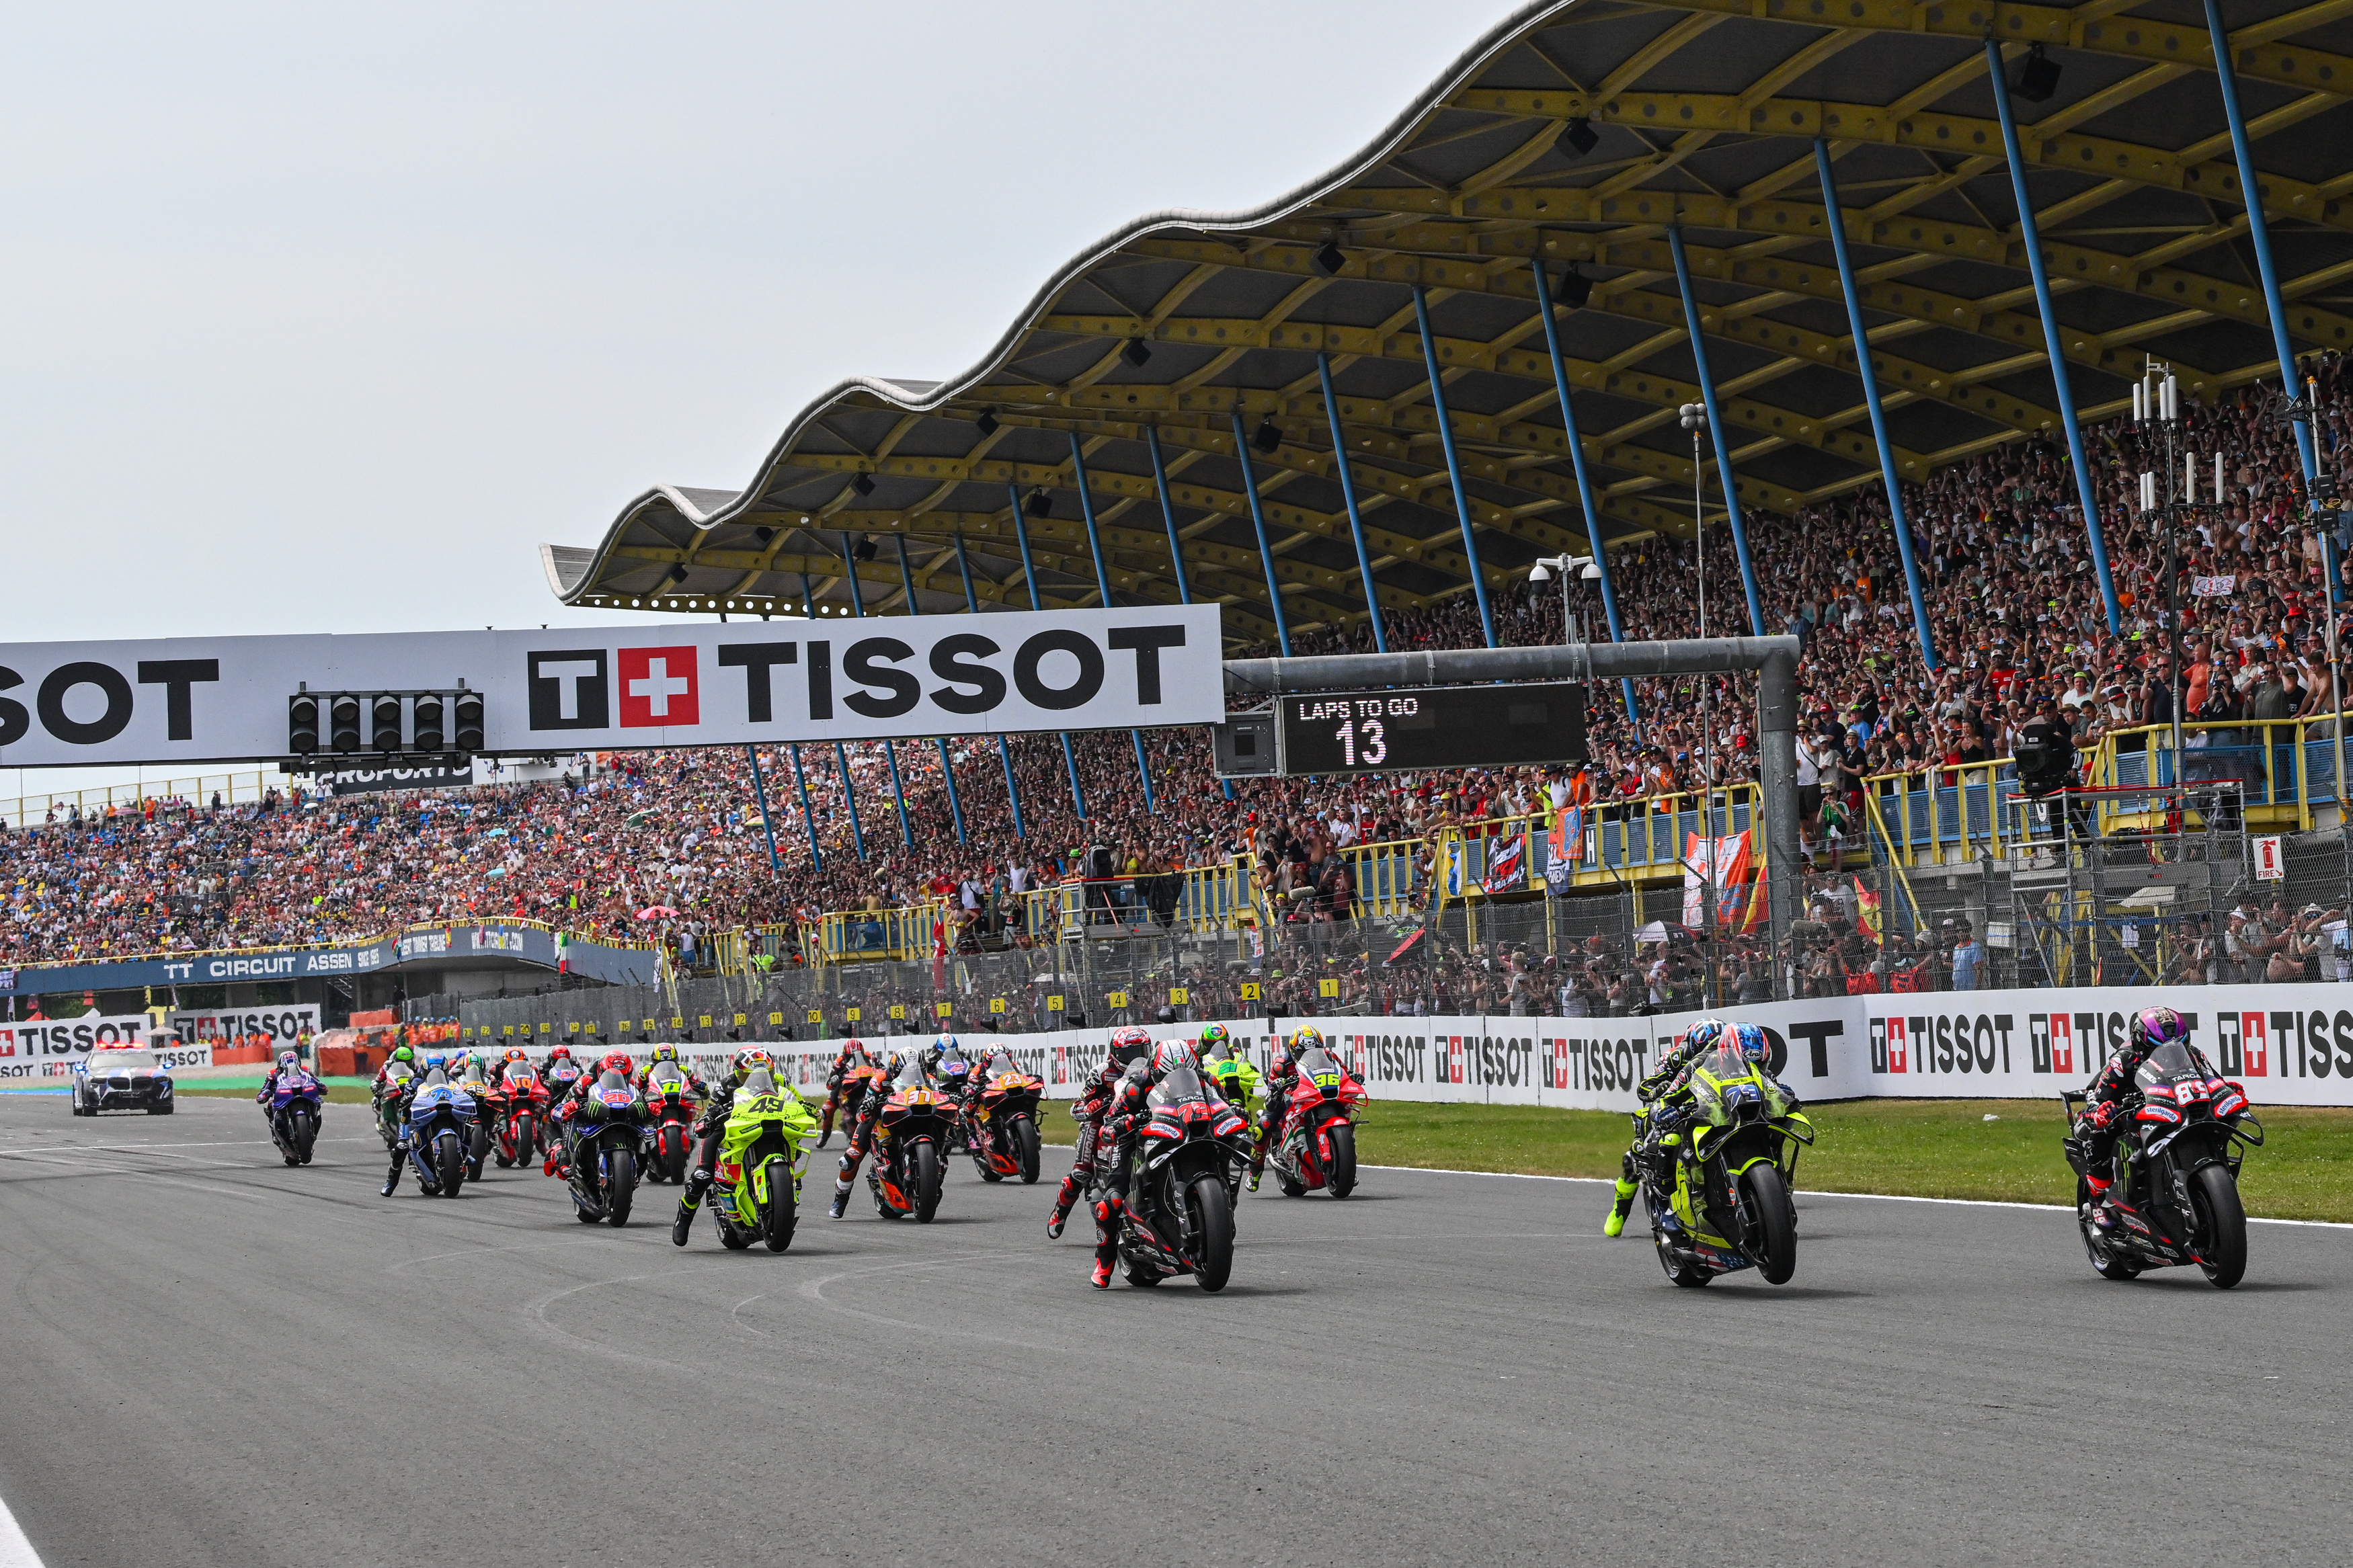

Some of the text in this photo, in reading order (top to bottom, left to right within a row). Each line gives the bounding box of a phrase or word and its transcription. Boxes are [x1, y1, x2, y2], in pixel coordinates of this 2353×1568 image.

[718, 625, 1186, 722] TISSOT
[1300, 698, 1419, 720] LAPS TO GO
[1336, 719, 1386, 765] 13
[1586, 829, 1595, 864] H
[2258, 869, 2275, 878] FIRE
[163, 963, 194, 979] TT
[209, 957, 296, 977] CIRCUIT
[307, 952, 352, 971] ASSEN
[1246, 984, 1254, 999] 2
[1326, 981, 1331, 995] 1
[1052, 997, 1059, 1009] 5
[1115, 993, 1121, 1006] 4
[1175, 990, 1183, 1003] 3
[942, 1005, 947, 1015] 7
[994, 1000, 1000, 1011] 6
[736, 1014, 745, 1024] 12
[772, 1014, 780, 1022] 11
[809, 1012, 818, 1022] 10
[850, 1011, 855, 1020] 9
[894, 1007, 900, 1018] 8
[220, 1011, 313, 1044] TISSOT
[621, 1022, 629, 1030] 16
[673, 1019, 682, 1027] 14
[701, 1018, 710, 1026] 13
[521, 1025, 529, 1033] 20
[18, 1022, 141, 1055] TISSOT
[1908, 1014, 2014, 1074] TISSOT
[1365, 1035, 1426, 1083] TISSOT
[1464, 1036, 1533, 1087] TISSOT
[1743, 1050, 1763, 1060] Arai
[1066, 1044, 1106, 1083] TISSOT
[1218, 1062, 1238, 1075] 21
[1568, 1038, 1647, 1092] TISSOT
[514, 1077, 532, 1089] 10
[1002, 1074, 1022, 1086] 23
[1314, 1074, 1340, 1089] 36
[2171, 1073, 2201, 1082] TARGA
[2208, 1079, 2224, 1087] BS
[431, 1088, 453, 1102] 73
[660, 1083, 681, 1094] 11
[2174, 1080, 2210, 1106] 89
[603, 1094, 631, 1104] 20
[907, 1089, 932, 1104] 37
[748, 1097, 785, 1113] 49
[2219, 1096, 2241, 1114] sterilgarda
[2146, 1107, 2176, 1120] sterilgarda
[1151, 1123, 1179, 1137] sterilgarda
[1218, 1118, 1242, 1134] sterilgarda
[1084, 1128, 1097, 1163] DUCATI
